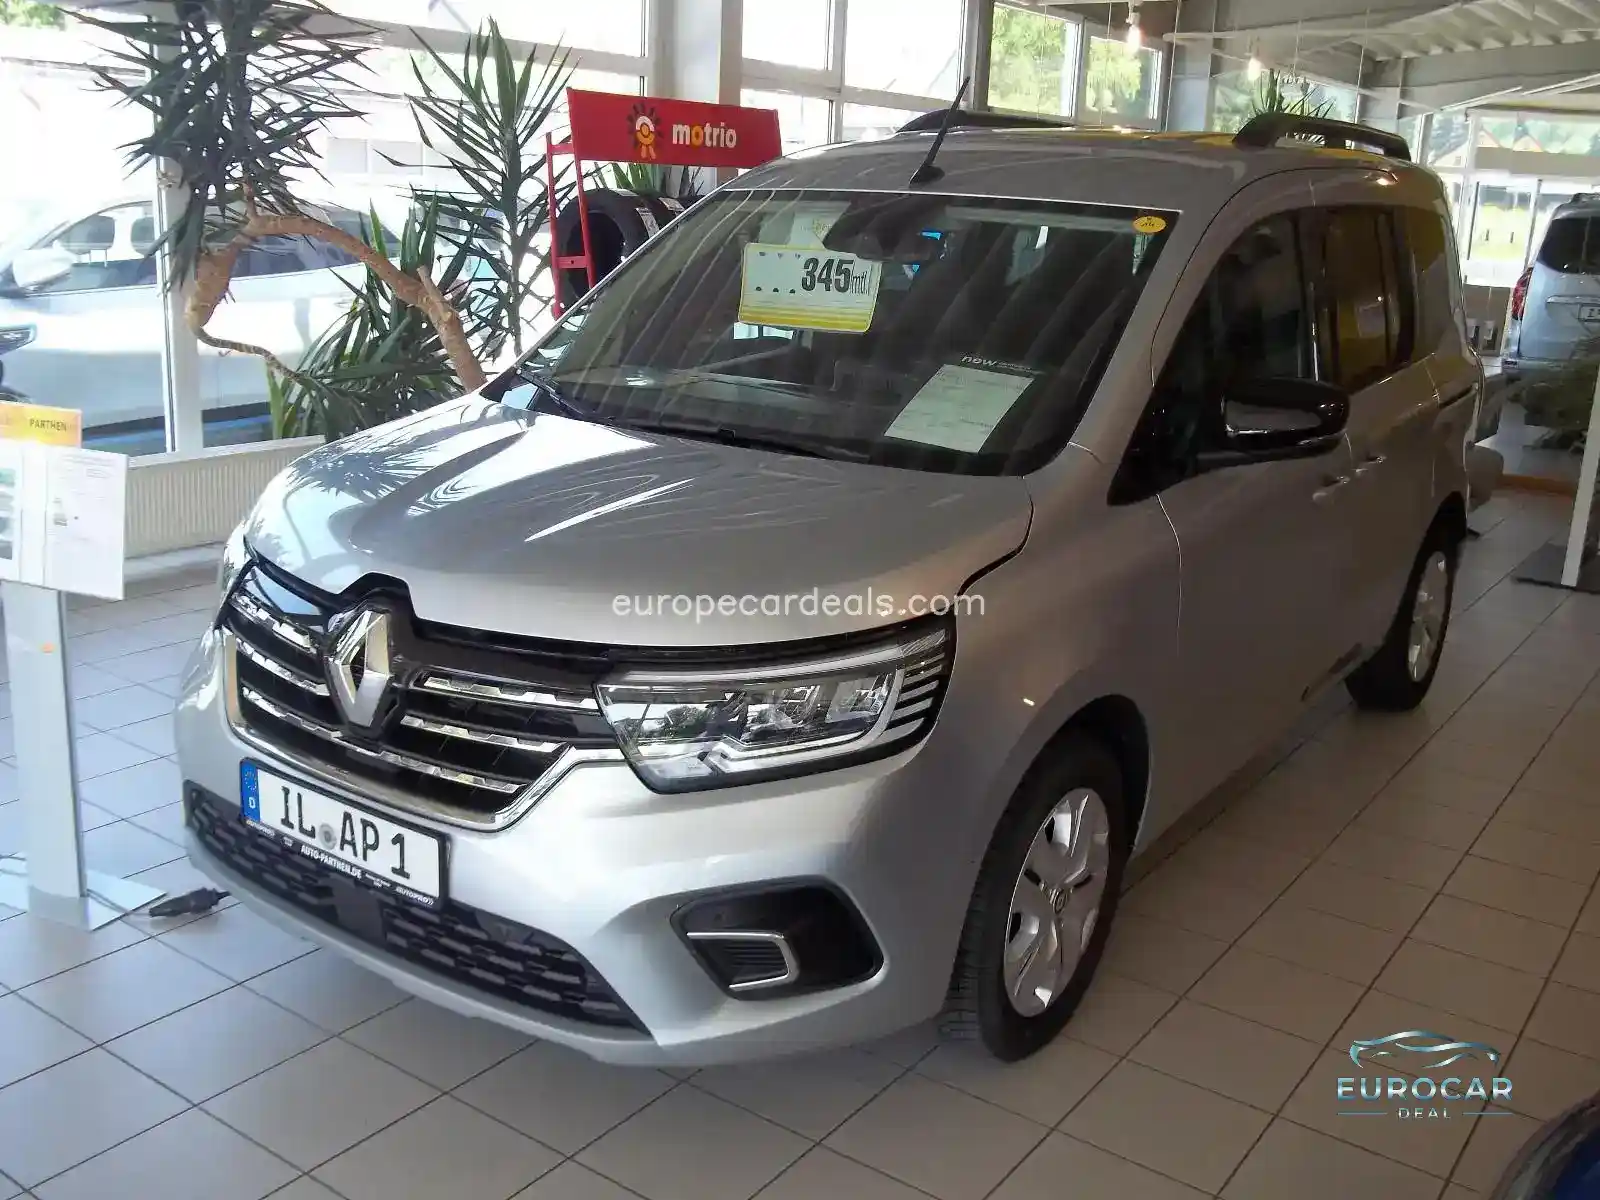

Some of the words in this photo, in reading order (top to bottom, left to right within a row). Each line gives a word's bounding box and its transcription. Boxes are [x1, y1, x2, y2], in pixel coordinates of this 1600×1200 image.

[672, 122, 737, 148] motrio
[801, 258, 853, 293] 345
[29, 418, 67, 431] PARTHEN
[280, 786, 316, 839] IL
[340, 811, 380, 862] AP
[390, 833, 411, 880] 1
